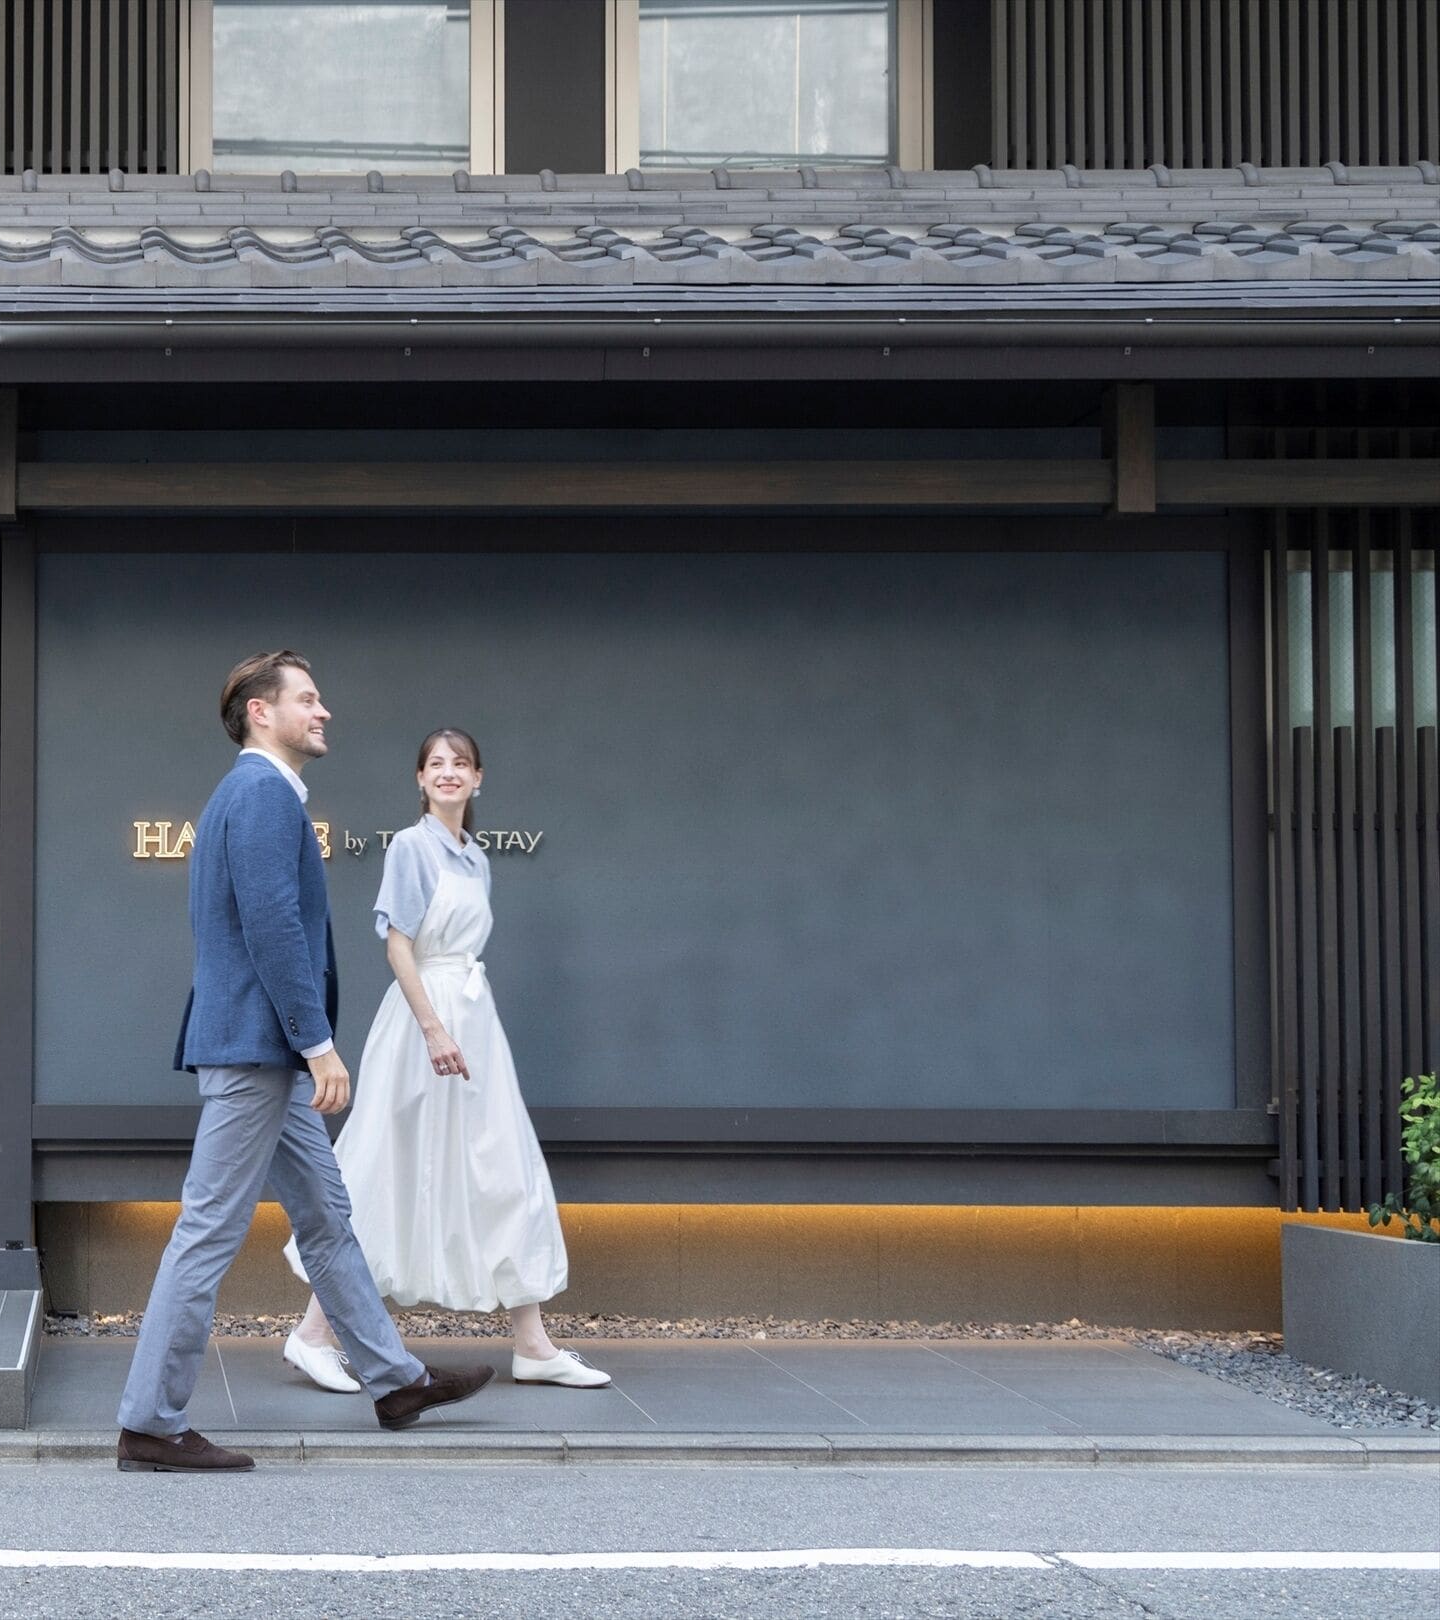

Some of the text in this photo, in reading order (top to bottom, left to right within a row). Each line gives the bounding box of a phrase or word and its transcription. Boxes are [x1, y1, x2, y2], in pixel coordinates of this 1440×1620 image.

[133, 821, 331, 858] HAE
[344, 830, 368, 855] by
[475, 830, 544, 853] STAY
